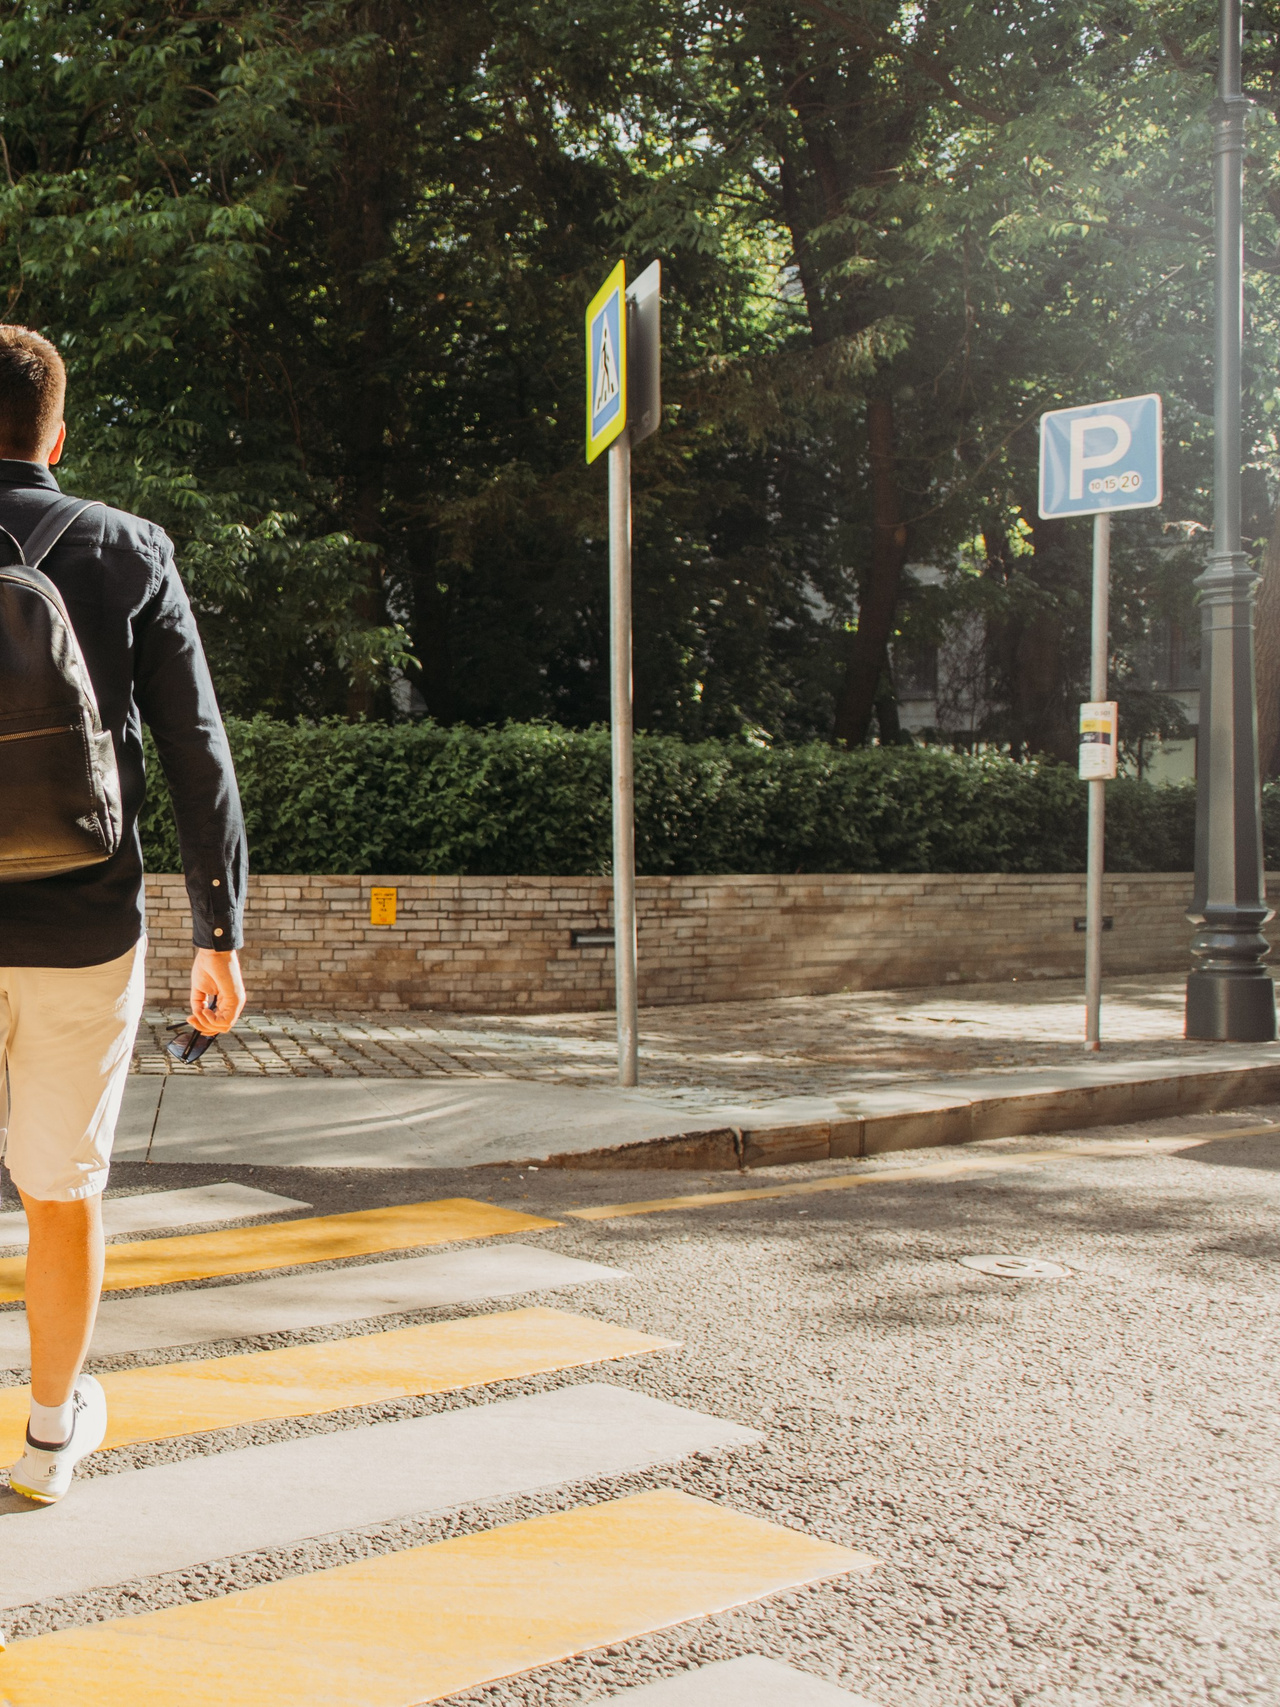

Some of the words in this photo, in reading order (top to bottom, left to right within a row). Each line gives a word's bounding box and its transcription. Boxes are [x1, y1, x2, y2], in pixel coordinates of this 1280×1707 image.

[1069, 414, 1131, 500] P
[1091, 482, 1101, 490] 10
[1105, 479, 1116, 489] 15
[1121, 474, 1140, 488] 20
